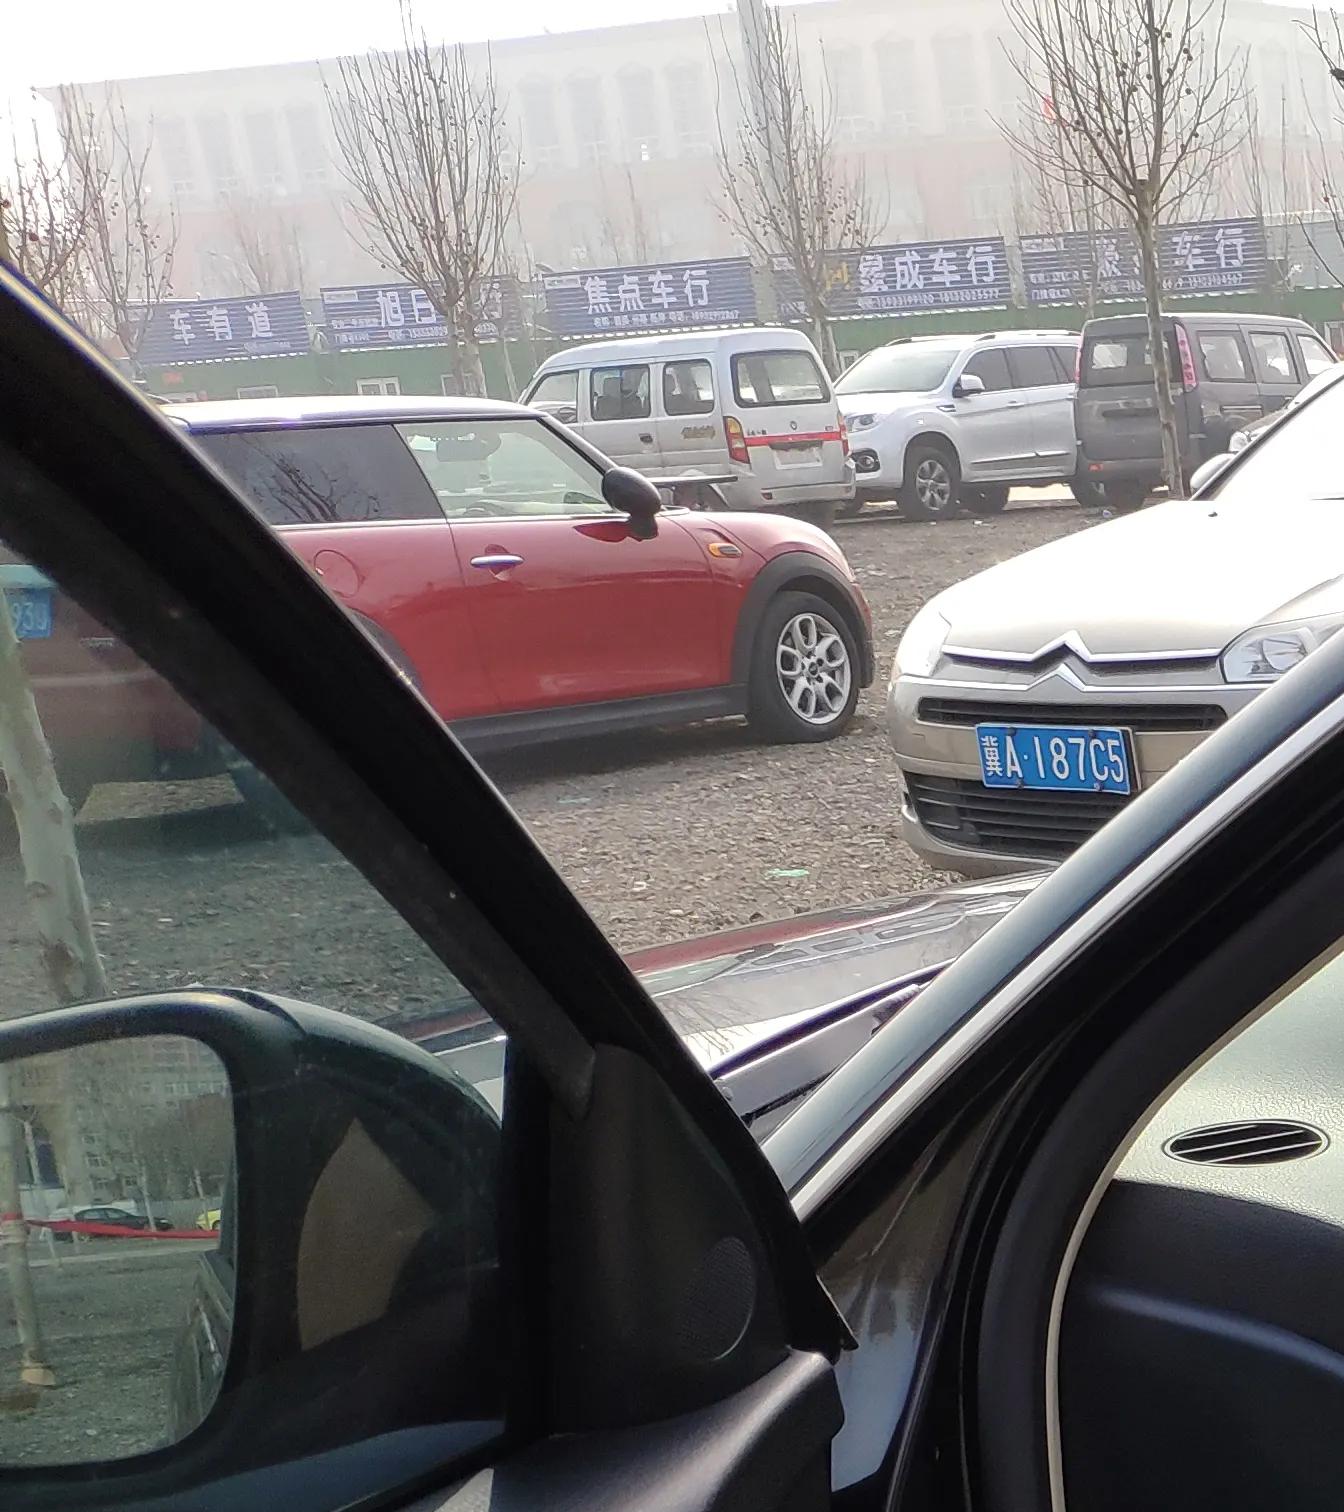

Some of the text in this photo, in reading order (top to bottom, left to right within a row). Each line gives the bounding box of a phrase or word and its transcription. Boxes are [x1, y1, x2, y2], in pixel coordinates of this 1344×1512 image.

[584, 269, 709, 314] 焦点车行
[169, 301, 273, 345] 车有道
[980, 734, 1124, 783] 冀A·187C5
